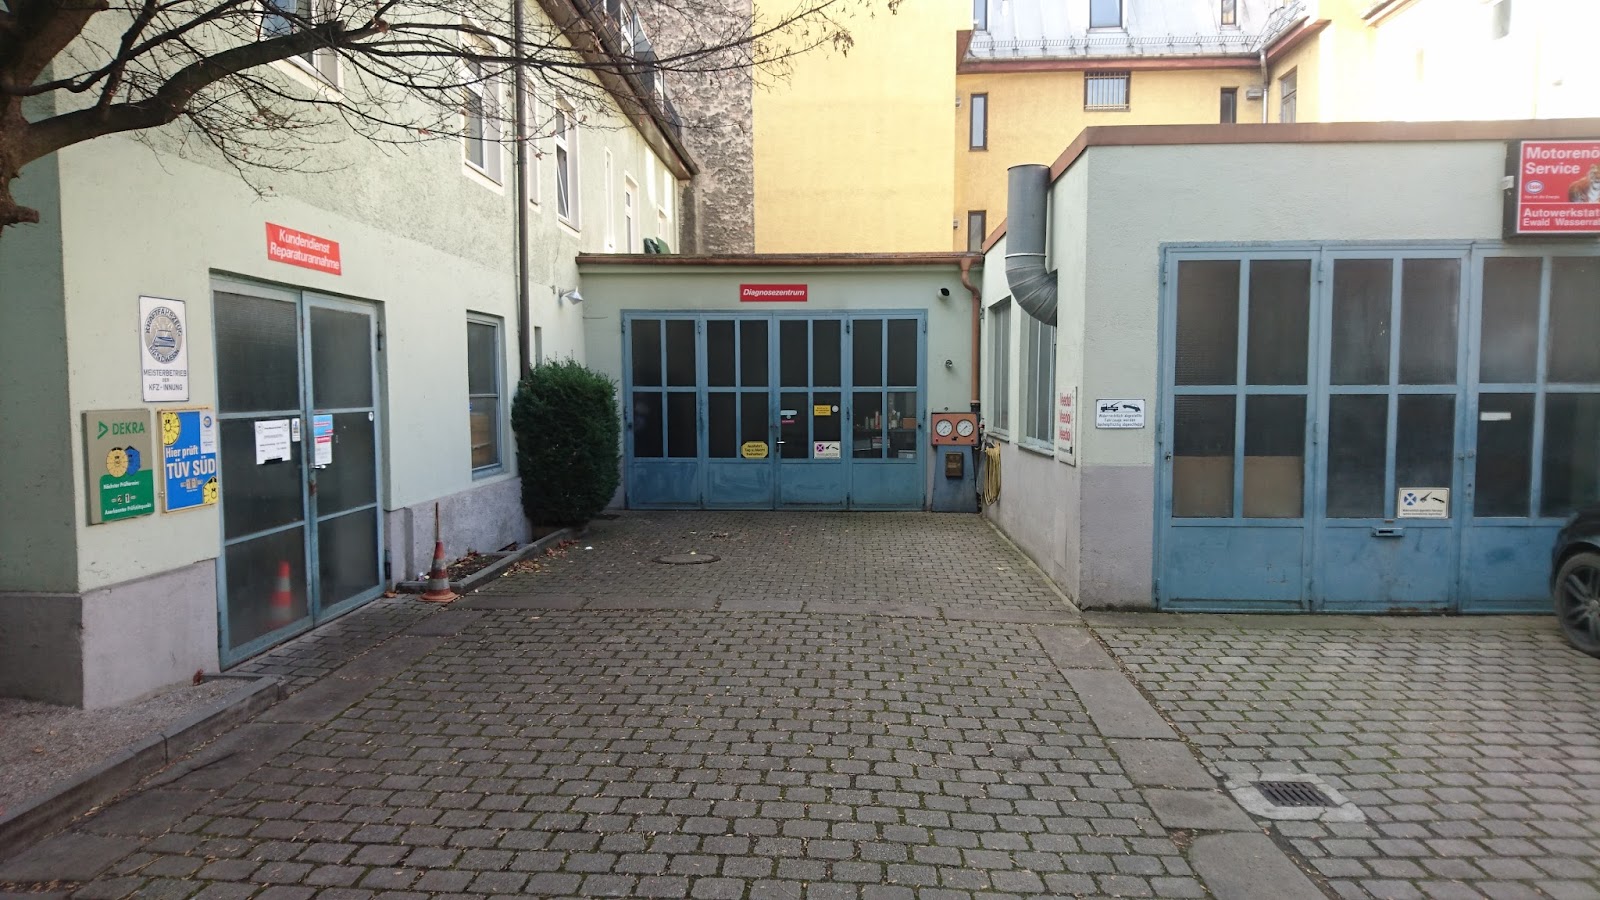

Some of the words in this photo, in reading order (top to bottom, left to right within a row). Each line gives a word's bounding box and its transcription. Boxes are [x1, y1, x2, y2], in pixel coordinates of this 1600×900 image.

[1526, 146, 1600, 159] Motorenö
[1525, 162, 1580, 174] Service
[1523, 218, 1550, 226] Ewald
[279, 228, 330, 254] Kundendienst
[270, 241, 340, 270] Reparaturannahme
[743, 288, 805, 297] Diagnosezentrum
[143, 369, 187, 377] MEISTERBETRIEB
[112, 422, 145, 435] DEKRA
[165, 447, 181, 458] Hier
[182, 445, 199, 459] prüft
[167, 459, 190, 479] TÜV
[192, 455, 216, 476] SÜD
